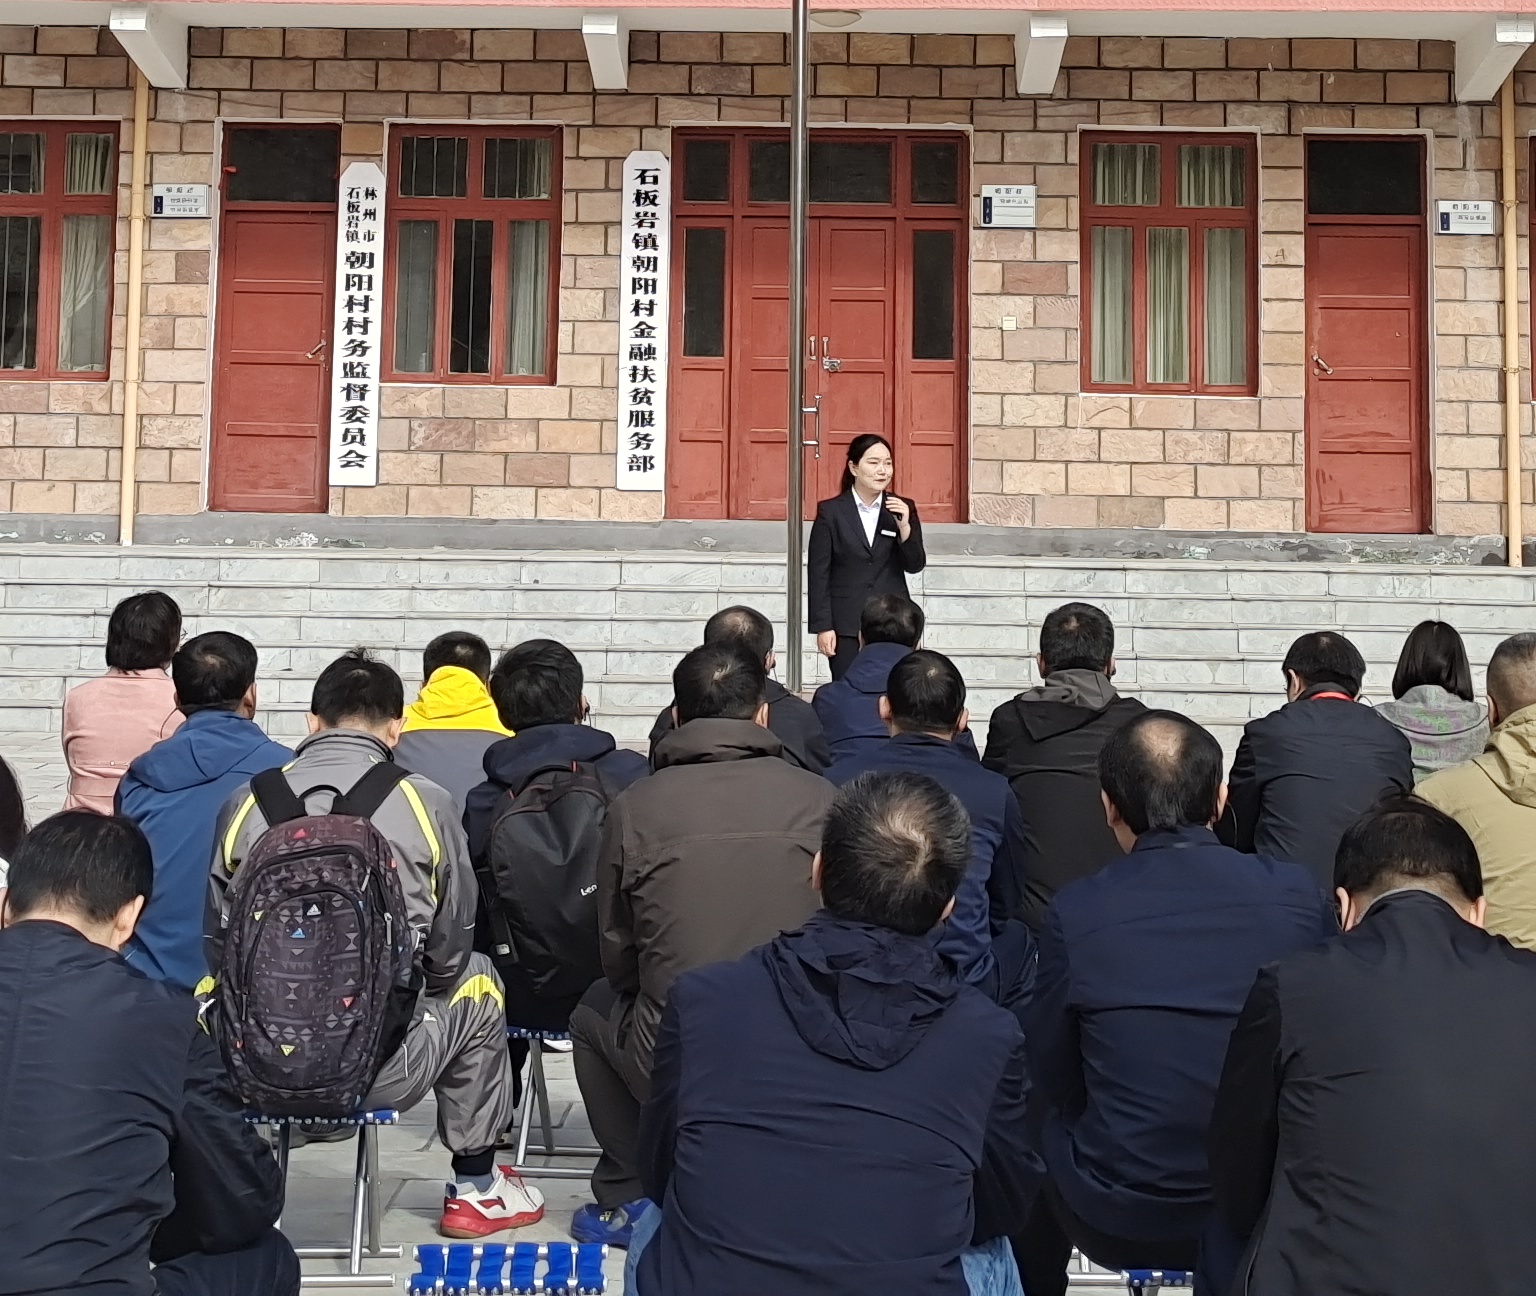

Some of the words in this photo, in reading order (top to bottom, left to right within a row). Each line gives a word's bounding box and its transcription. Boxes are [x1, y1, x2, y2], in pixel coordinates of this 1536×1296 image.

[345, 186, 362, 243] 石板岩镇
[362, 186, 379, 243] 林州市
[338, 250, 375, 470] 朝阳村村务监督委员会
[626, 168, 662, 473] 石板岩镇朝阳村金融扶贫服务部
